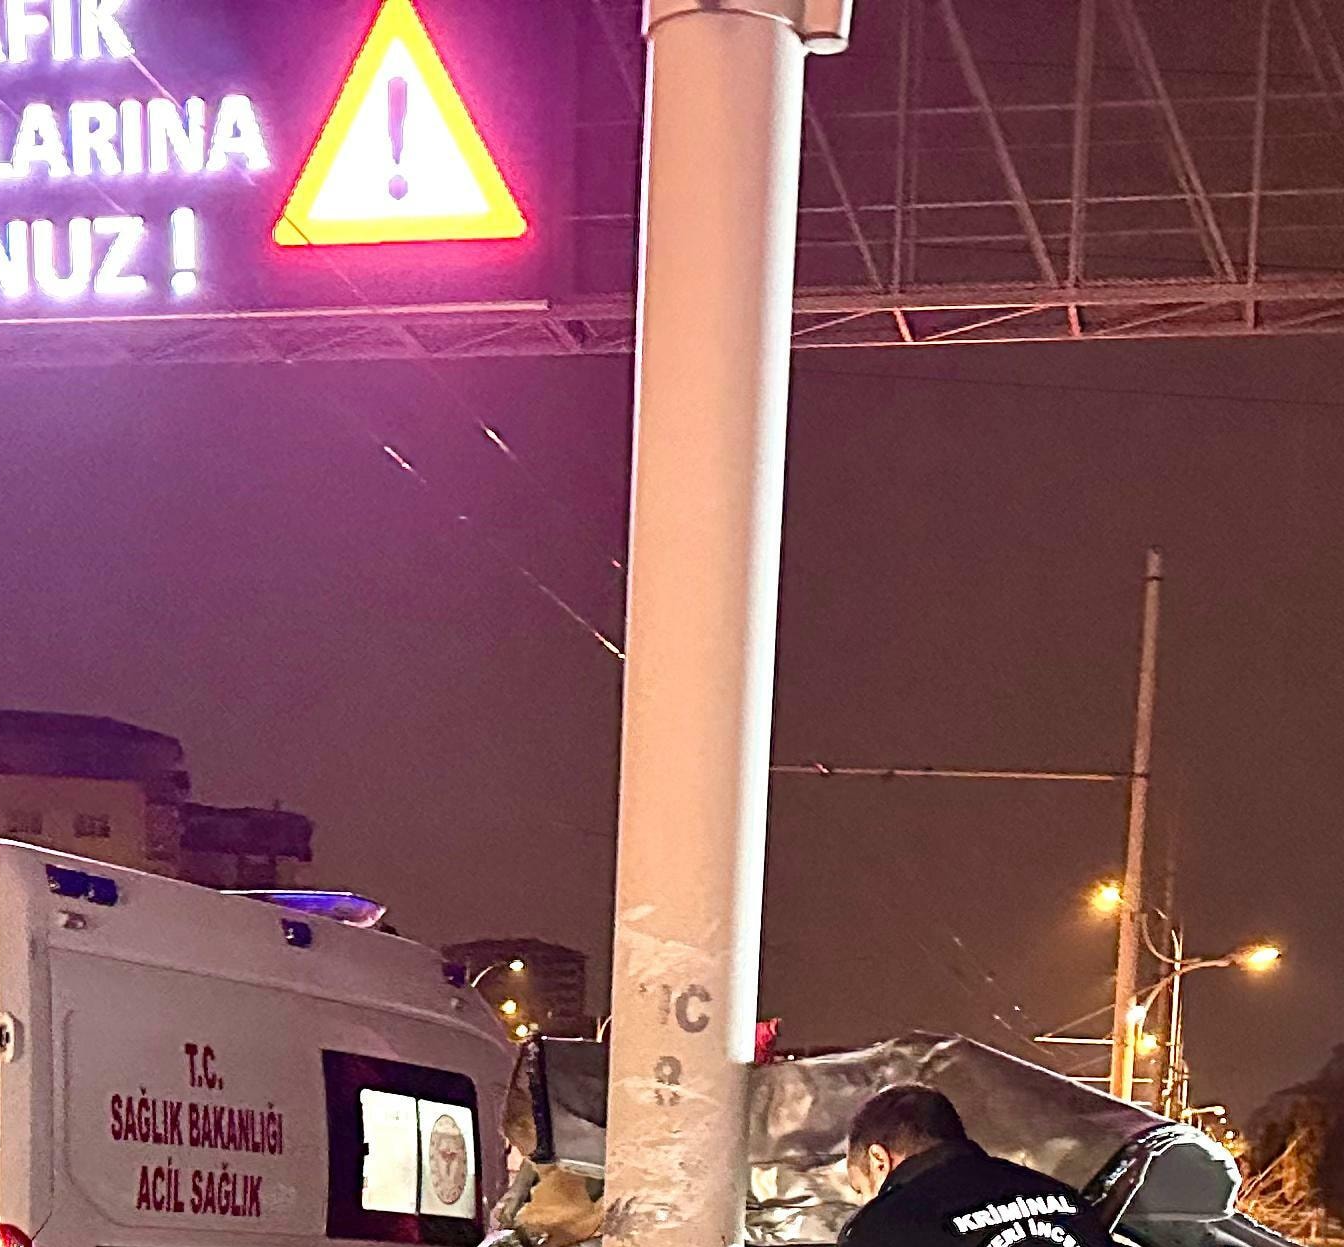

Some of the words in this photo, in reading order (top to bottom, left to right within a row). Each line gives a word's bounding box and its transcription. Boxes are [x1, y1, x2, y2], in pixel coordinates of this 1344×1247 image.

[184, 1042, 224, 1091] T.C.
[111, 1086, 184, 1146] SAĞLIK
[188, 1101, 283, 1155] BAKANLIĞI
[136, 1156, 185, 1213] ACİL
[190, 1162, 263, 1218] SAĞLIK
